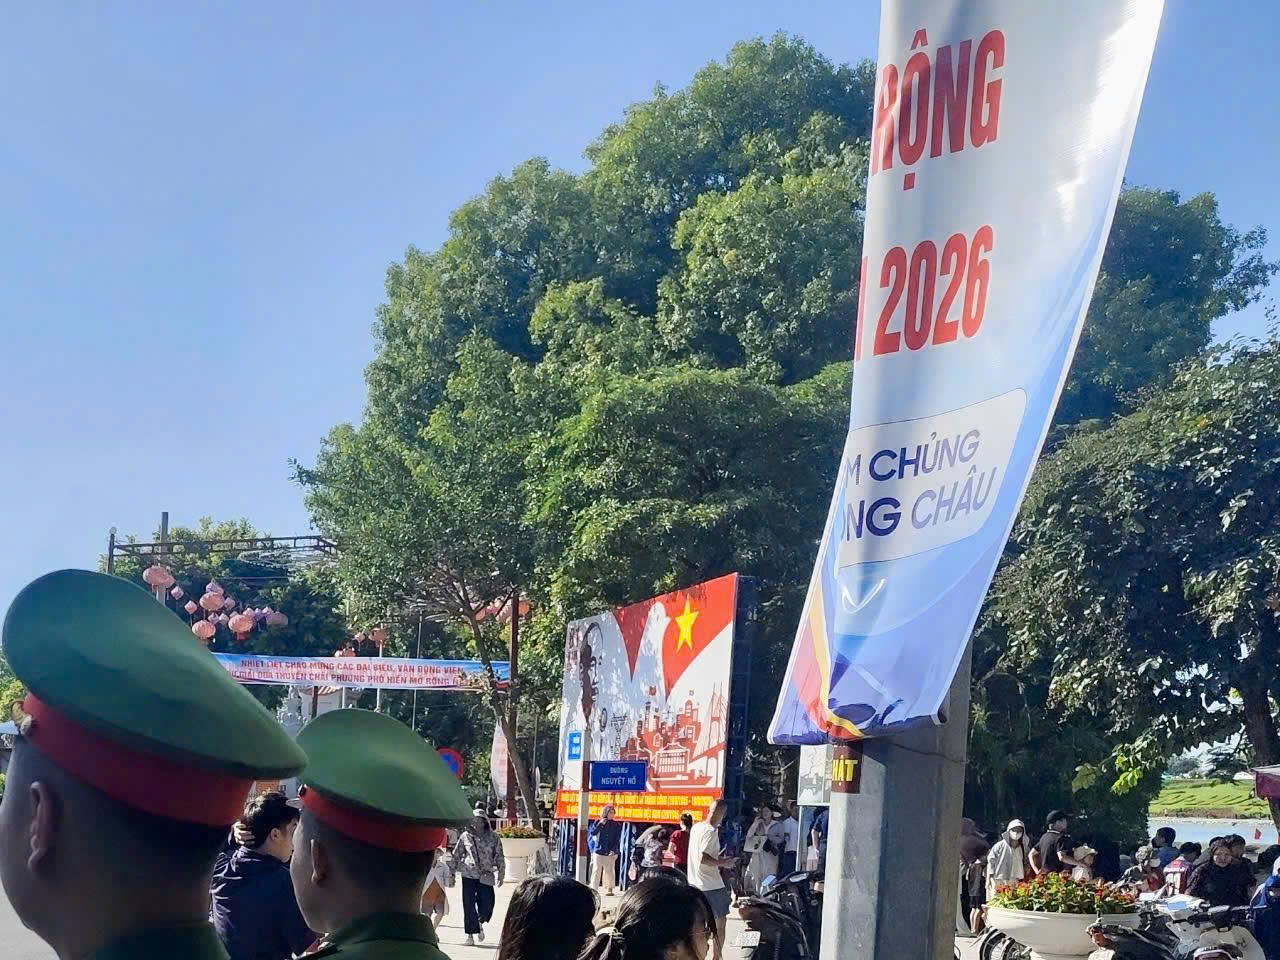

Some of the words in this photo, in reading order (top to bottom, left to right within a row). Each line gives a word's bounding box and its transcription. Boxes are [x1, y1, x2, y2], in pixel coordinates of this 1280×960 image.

[871, 28, 1006, 190] RỘNG
[873, 225, 993, 356] 2026
[868, 429, 981, 482] CHỦNG
[911, 464, 998, 530] CHÂU
